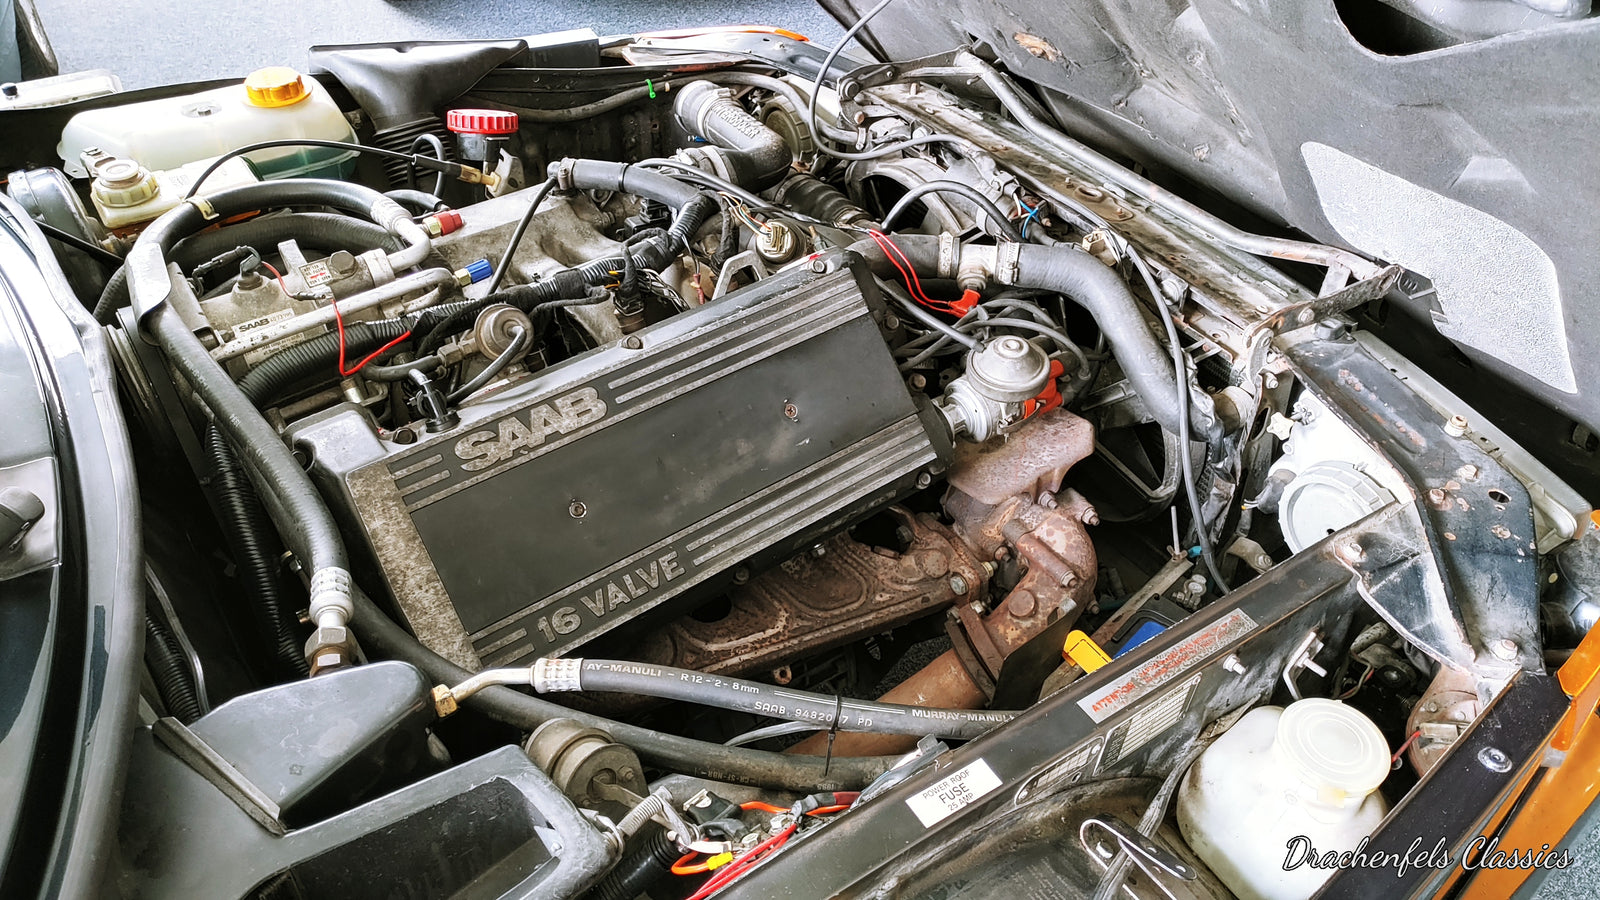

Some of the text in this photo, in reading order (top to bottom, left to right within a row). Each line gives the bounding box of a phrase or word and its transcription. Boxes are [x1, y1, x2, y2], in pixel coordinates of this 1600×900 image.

[238, 318, 270, 332] SAAB
[454, 386, 607, 472] SAAB
[537, 550, 686, 643] 16 VALVE
[754, 701, 786, 716] SAAB
[795, 708, 849, 724] 948207
[922, 769, 971, 799] POWER ROOF
[938, 782, 970, 804] FUSE
[947, 792, 974, 811] 25 AMP
